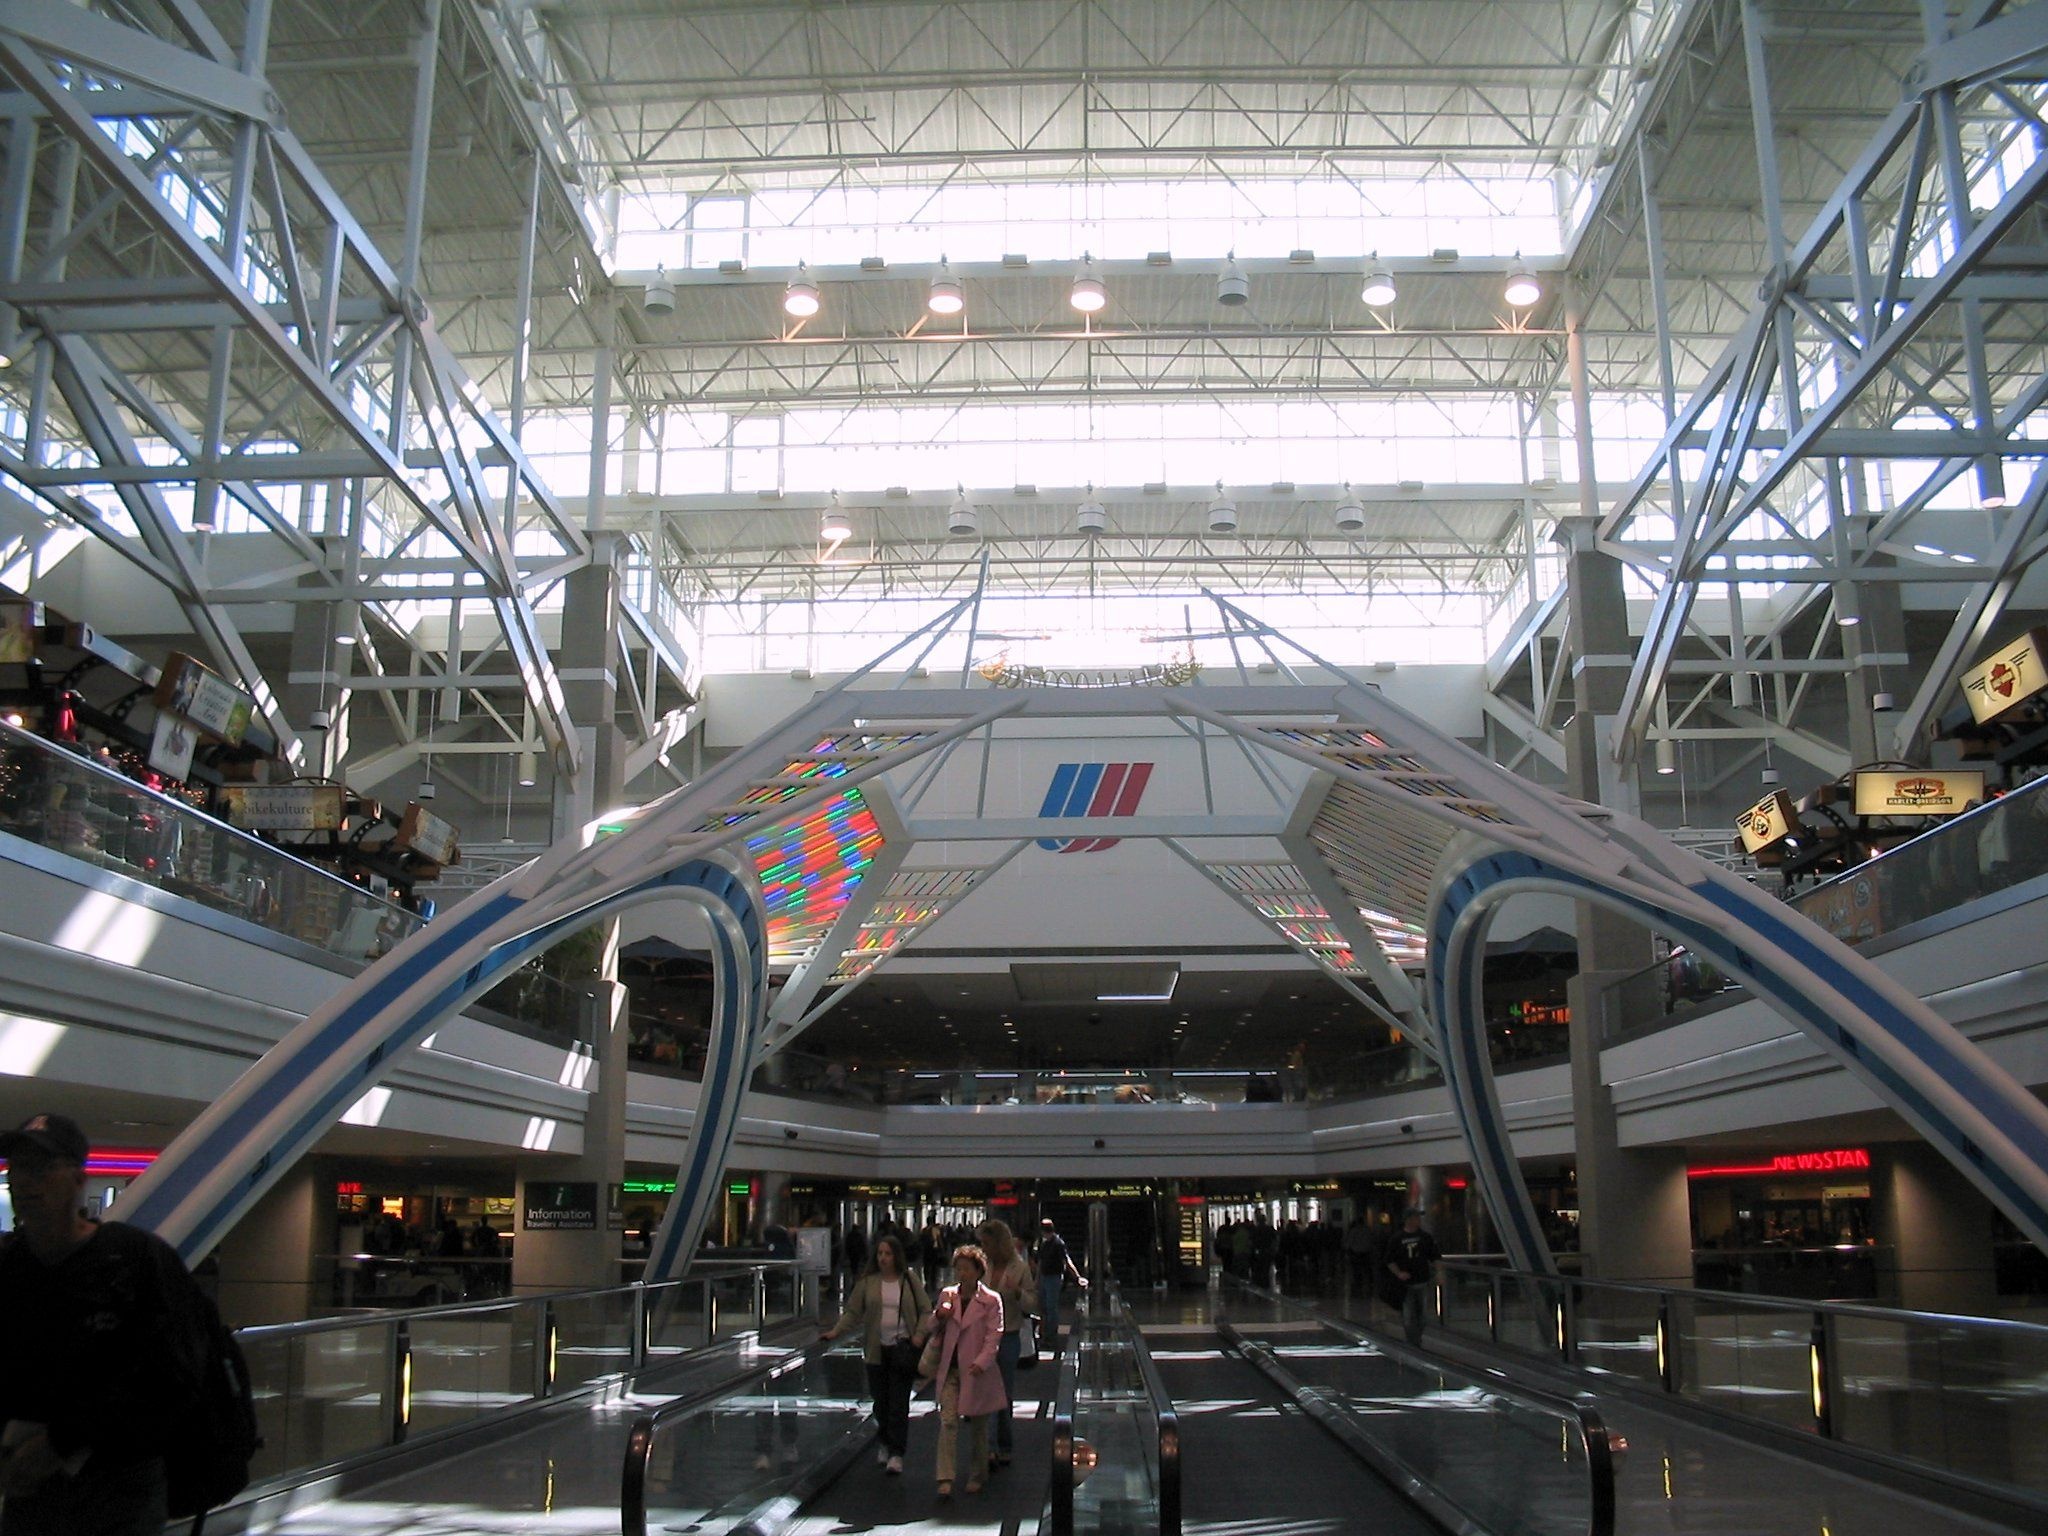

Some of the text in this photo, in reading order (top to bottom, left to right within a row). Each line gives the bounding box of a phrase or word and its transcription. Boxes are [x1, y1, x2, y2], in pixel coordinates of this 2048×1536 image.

[1774, 1149, 1870, 1171] NEWSSTAN
[1058, 1189, 1084, 1198] Smoking
[528, 1208, 592, 1219] Information
